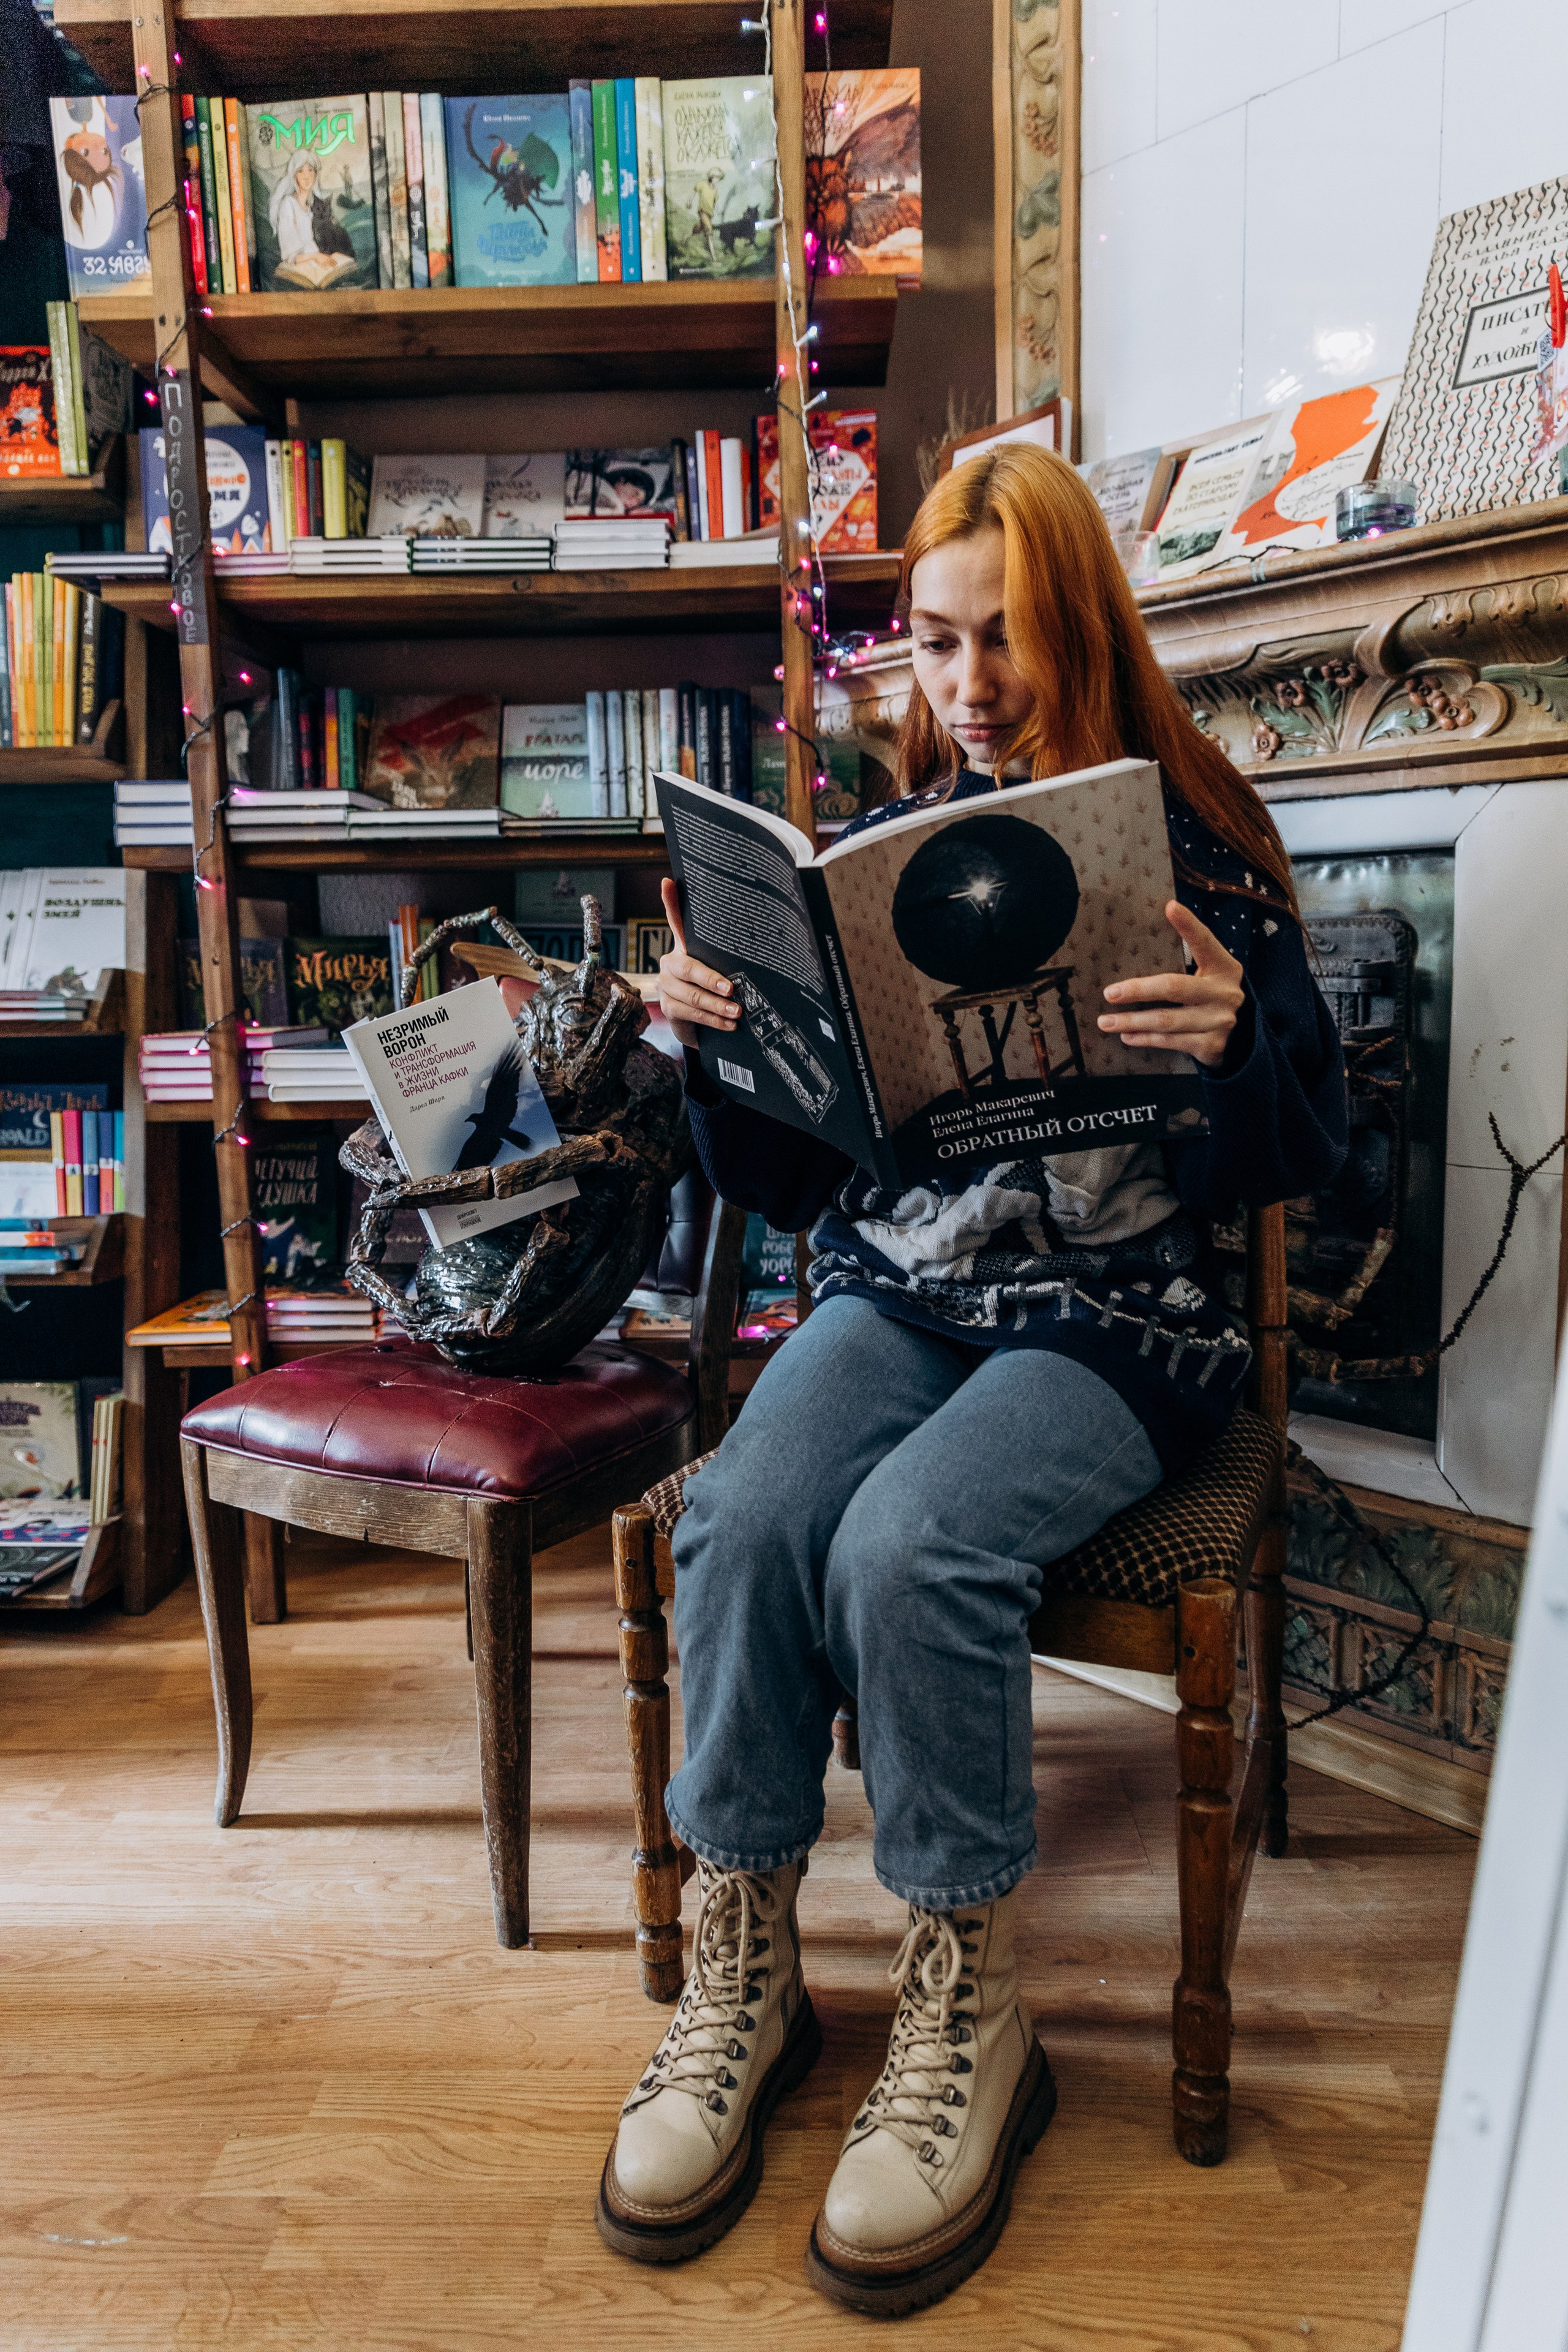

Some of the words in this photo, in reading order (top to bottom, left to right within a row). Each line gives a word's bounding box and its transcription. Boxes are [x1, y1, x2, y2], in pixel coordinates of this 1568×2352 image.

[258, 113, 356, 157] МИЯ
[377, 1006, 450, 1045] НЕЗРИМЫЙ
[383, 1032, 427, 1059] ВОРОН
[389, 1043, 439, 1069] КОНФЛИКТ
[400, 1041, 477, 1077] ТРАНСФОРМАЦИЯ
[402, 1078, 439, 1098] ФРАНЦА
[439, 1066, 469, 1085] КАФКИ
[404, 1066, 440, 1087] ЖИЗНИ
[410, 1101, 428, 1113] Дарел
[429, 1095, 445, 1106] Шарп
[929, 1107, 973, 1126] Игорь
[975, 1090, 1056, 1114] Макаревич
[932, 1120, 974, 1139] Елена
[976, 1107, 1035, 1128] Елагина
[937, 1117, 1063, 1159] ОБРАТНЫЙ
[1067, 1104, 1158, 1133] ОТСЧЕТ
